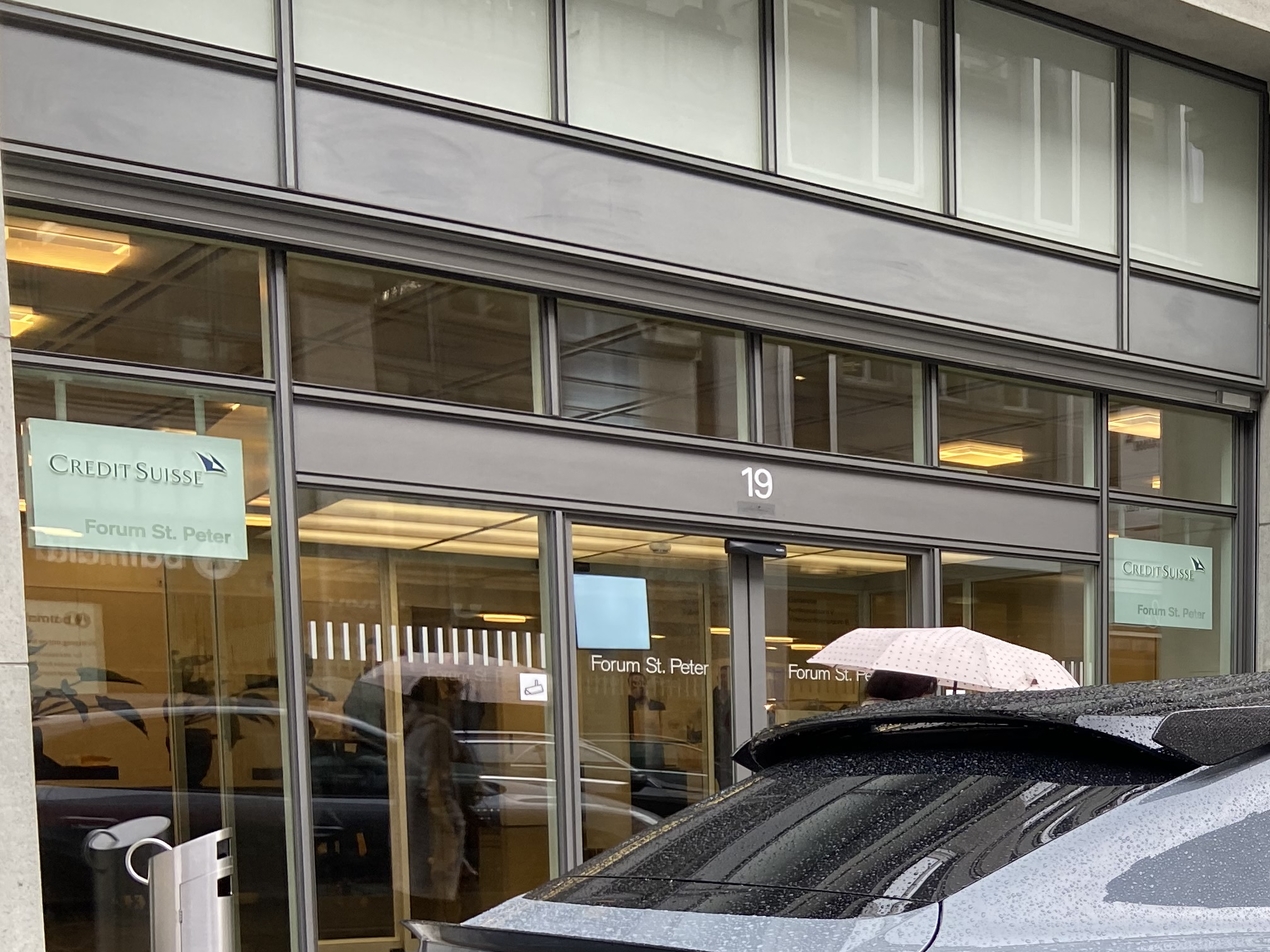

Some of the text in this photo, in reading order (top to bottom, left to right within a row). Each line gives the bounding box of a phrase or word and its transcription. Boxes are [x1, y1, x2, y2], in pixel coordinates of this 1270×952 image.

[48, 454, 204, 487] CREDIT SUISSE
[741, 466, 773, 499] 19
[84, 518, 232, 544] Forum St. Peter
[1121, 560, 1195, 582] CREDIT SUISSE
[1137, 604, 1206, 620] Forum St. Peter
[591, 654, 709, 676] Forum St. Peter
[788, 663, 831, 681] Forum
[835, 668, 852, 682] St.
